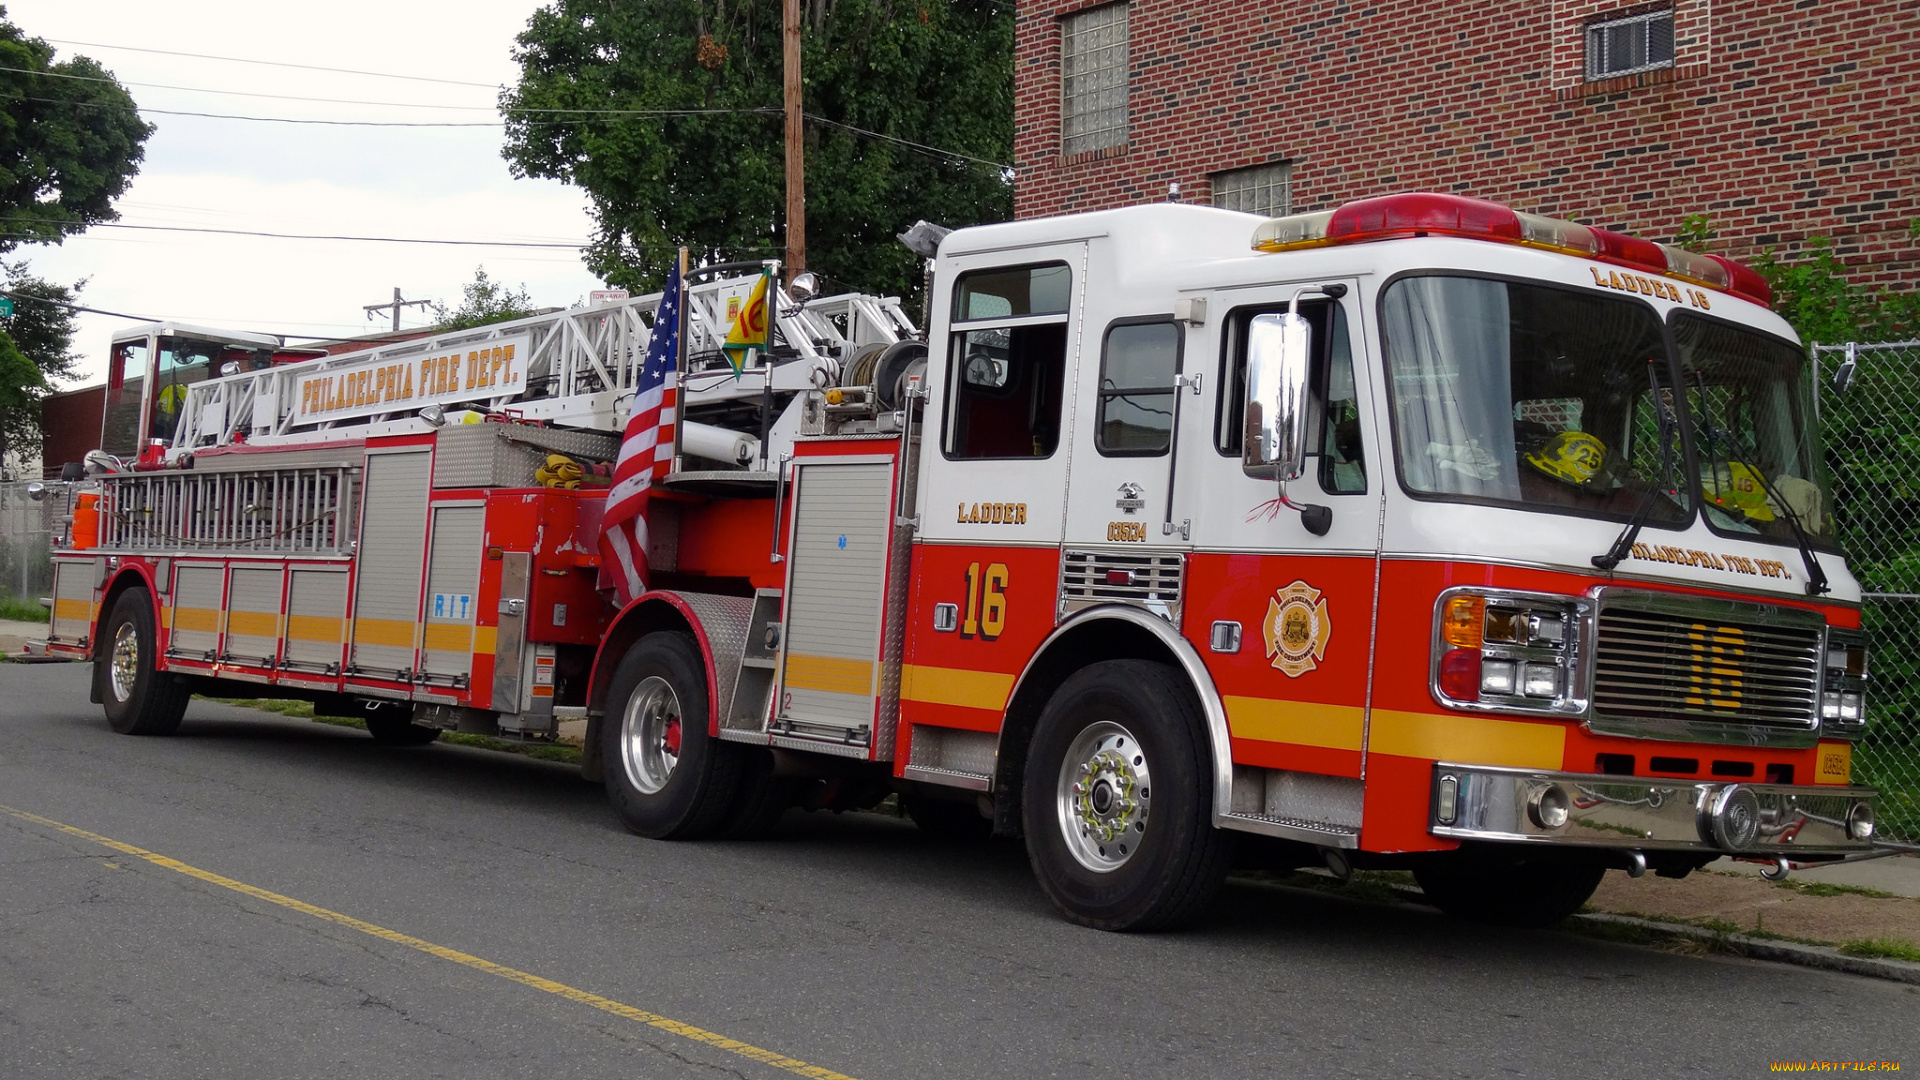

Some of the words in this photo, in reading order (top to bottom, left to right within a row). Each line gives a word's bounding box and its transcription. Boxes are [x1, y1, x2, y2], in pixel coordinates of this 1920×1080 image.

[1590, 266, 1682, 303] LADDER
[1686, 288, 1711, 310] 16
[301, 362, 414, 414] PHILADELPHIA
[419, 354, 461, 397] FIRE
[466, 344, 518, 389] DEPT.
[1577, 447, 1600, 469] 25
[957, 502, 1027, 524] LADDER
[1107, 522, 1147, 542] 035134
[1629, 541, 1724, 571] HILADELPHIA
[1721, 554, 1758, 575] FIRE
[1753, 558, 1792, 580] DEPT.
[434, 594, 470, 619] RIT
[961, 562, 1010, 641] 16
[1280, 595, 1316, 612] PHILADELPHIA
[1274, 640, 1284, 656] FIRE
[1284, 640, 1317, 662] DEPARTMENT
[1684, 624, 1746, 715] 16
[784, 692, 793, 710] 2
